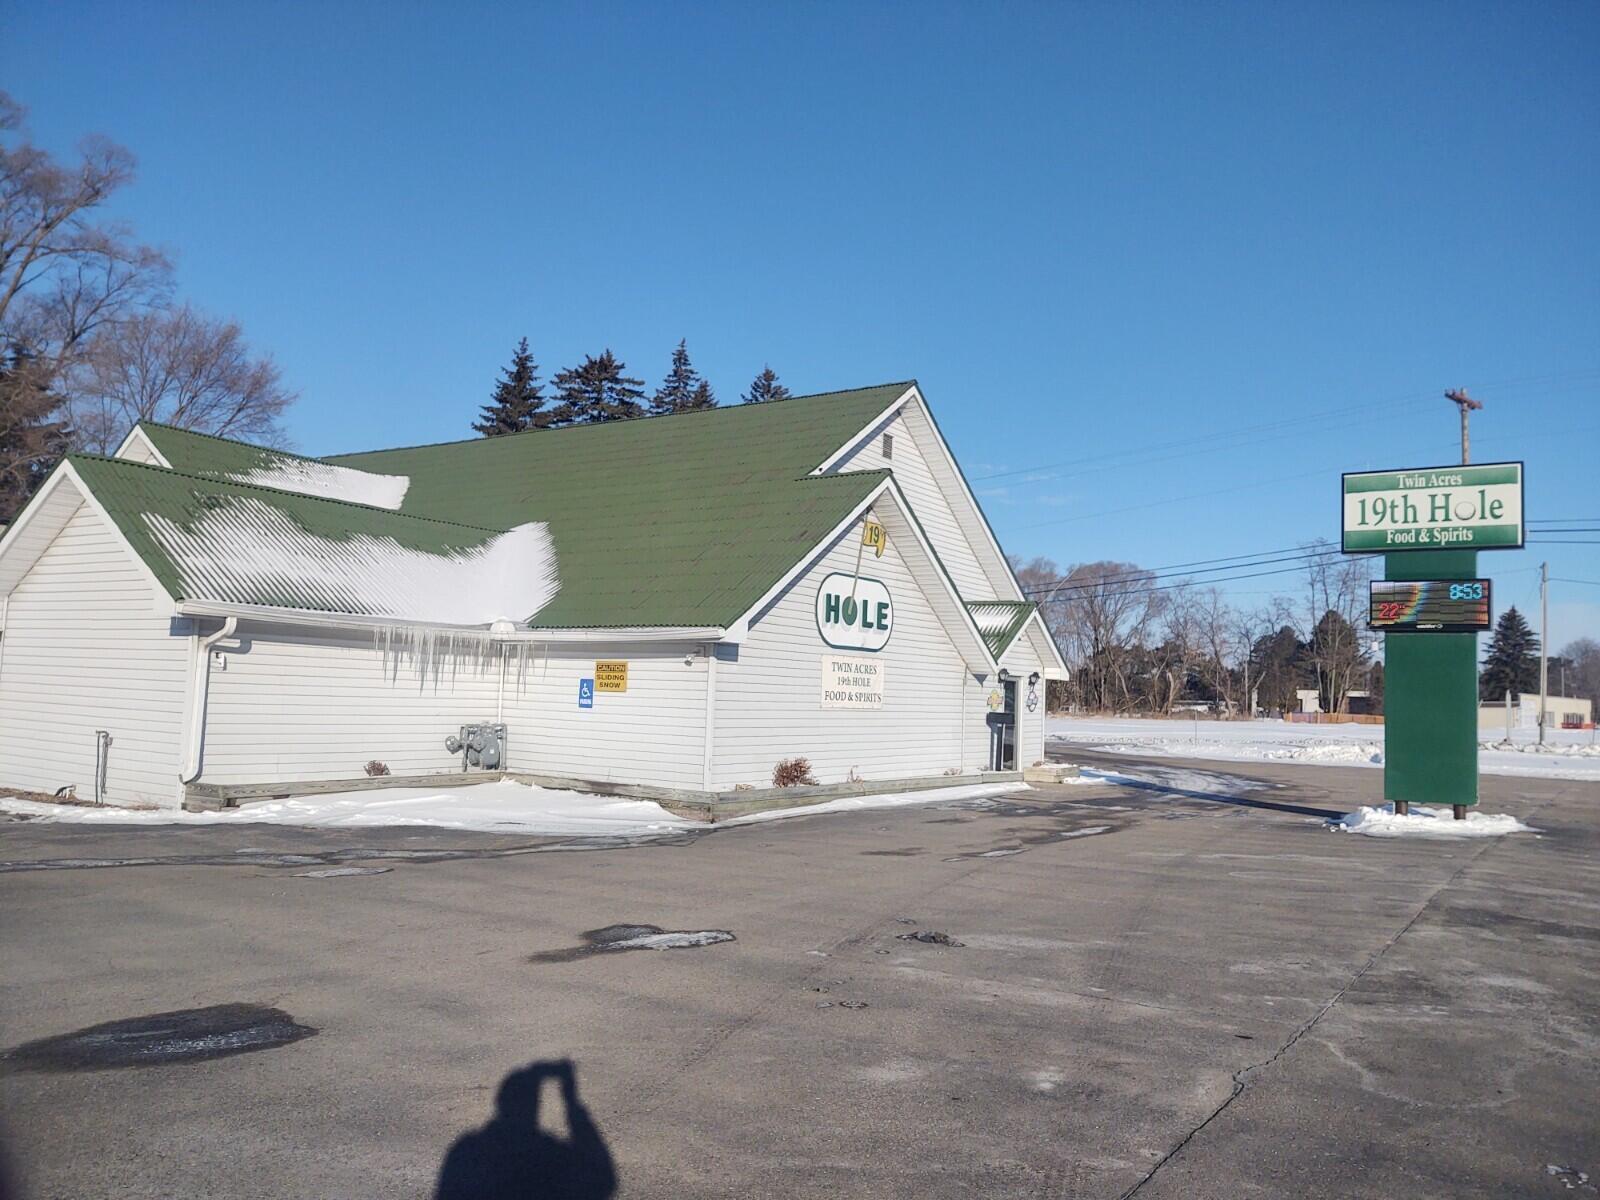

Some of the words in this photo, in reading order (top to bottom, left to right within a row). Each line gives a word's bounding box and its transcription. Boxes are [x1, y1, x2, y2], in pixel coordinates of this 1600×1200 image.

[1397, 474, 1426, 489] Twin
[1428, 474, 1462, 486] Acres
[1357, 494, 1418, 526] 19th
[1427, 489, 1504, 522] Hole
[1386, 529, 1415, 543] Food
[1418, 529, 1430, 542] &
[1433, 528, 1473, 546] Spirits
[1449, 584, 1483, 600] 8:53
[825, 593, 889, 631] HOLE
[832, 662, 852, 672] TWIN
[854, 664, 877, 675] ACRES
[853, 677, 871, 687] HOLE
[825, 691, 846, 701] FOOD
[848, 692, 853, 701] &
[855, 692, 881, 702] SPIRITS
